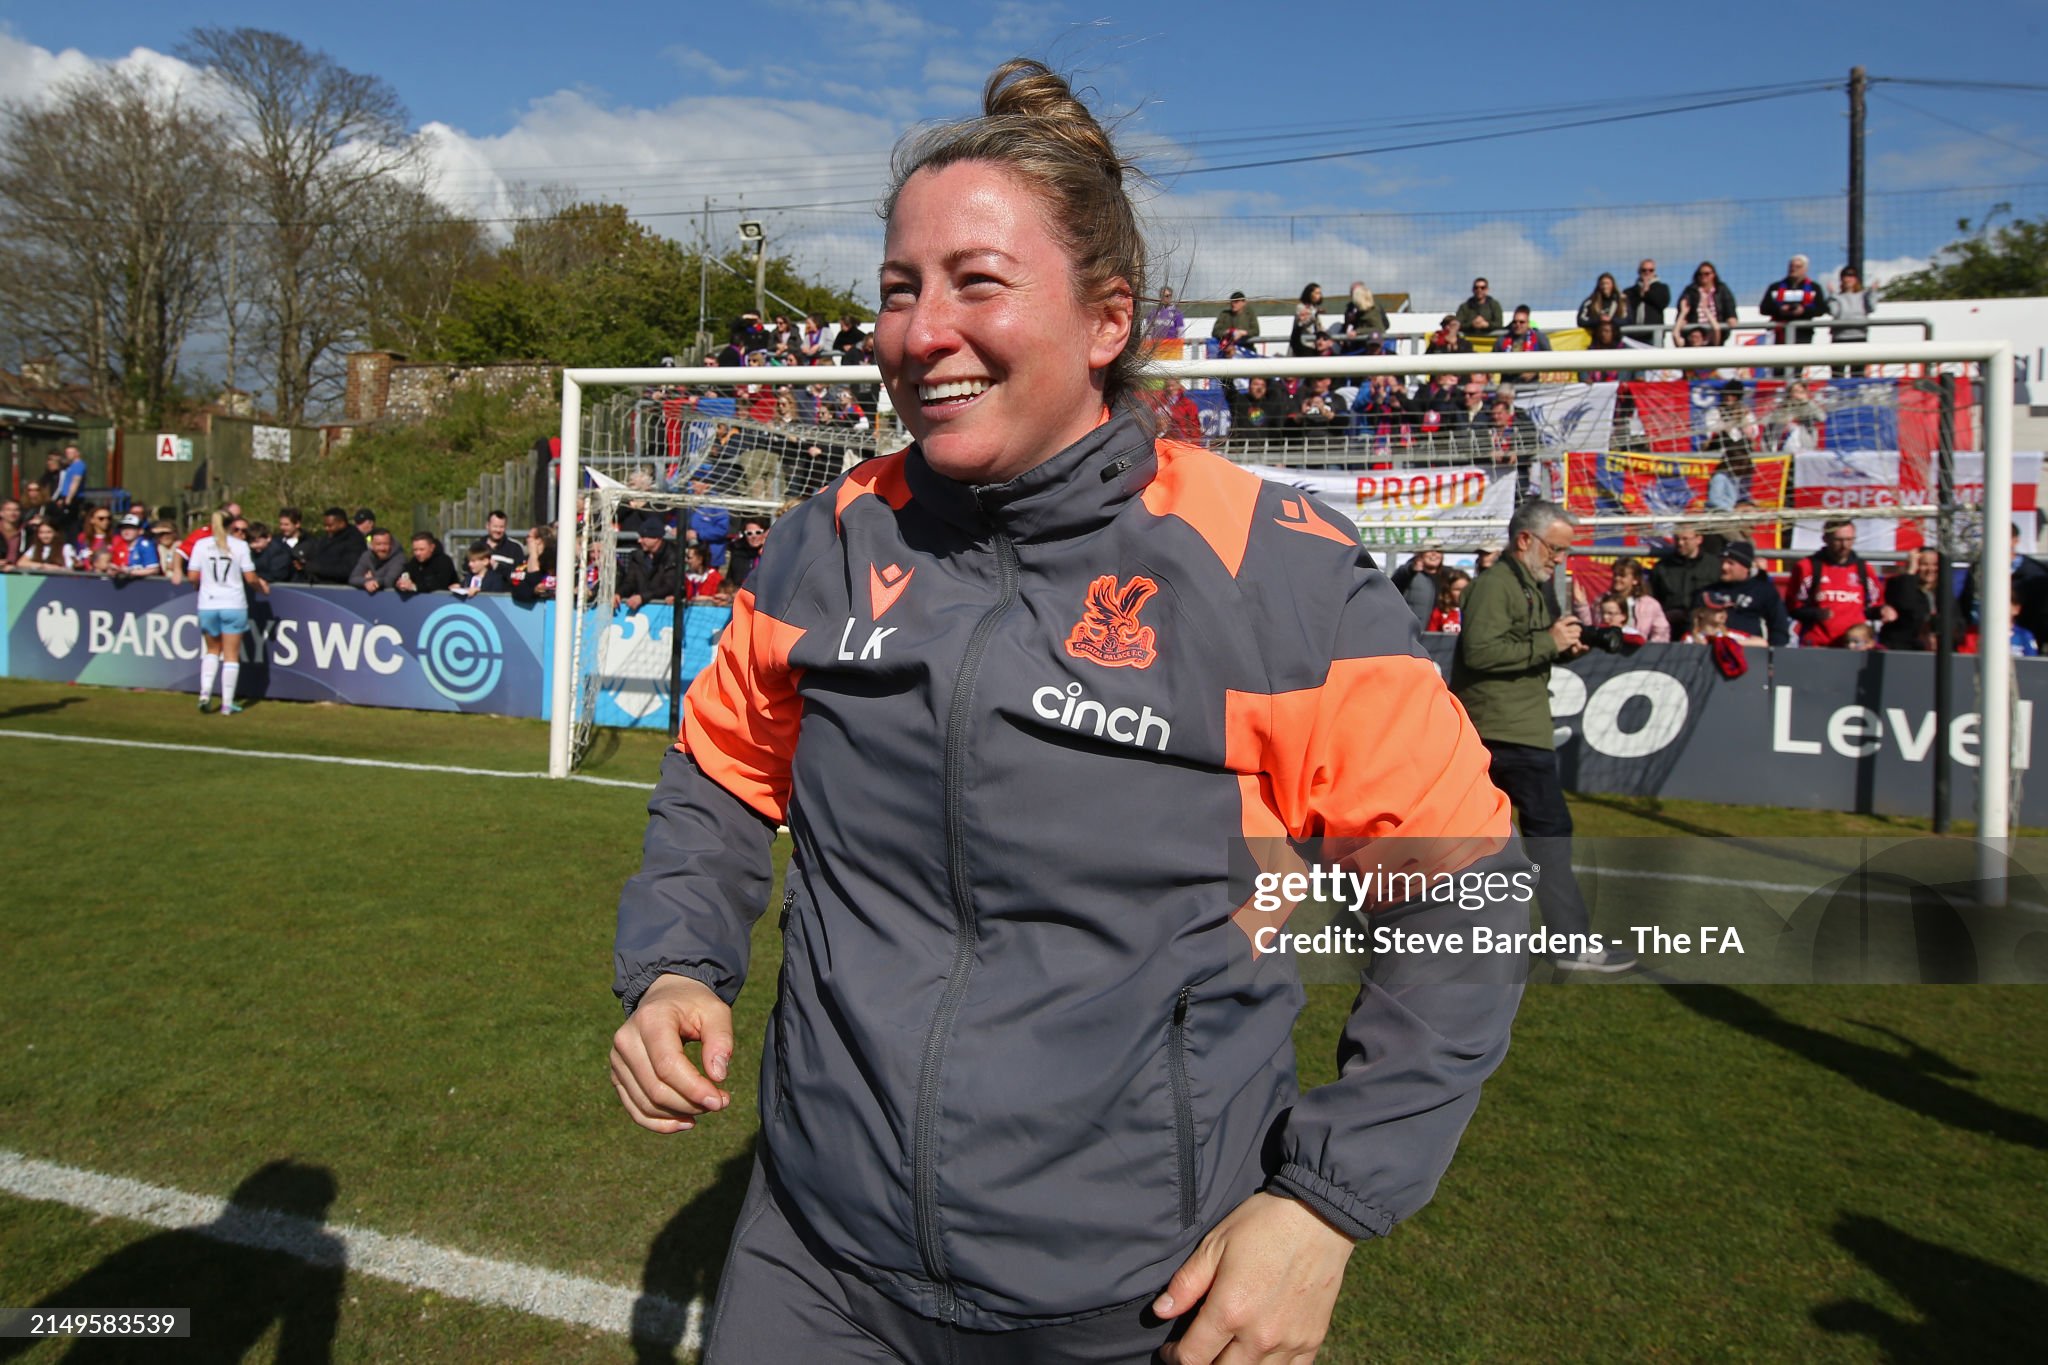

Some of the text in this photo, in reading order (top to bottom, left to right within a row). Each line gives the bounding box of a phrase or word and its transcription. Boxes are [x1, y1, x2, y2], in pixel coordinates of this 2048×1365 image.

[160, 437, 174, 457] A
[1356, 472, 1486, 510] PROUD
[1822, 489, 1894, 509] CPFC
[208, 556, 233, 583] 17
[1825, 590, 1863, 604] TDK
[88, 609, 405, 675] BARCYS WC
[1076, 643, 1103, 658] CRYSTAL
[1104, 651, 1131, 661] PALACE
[1032, 681, 1172, 751] cinch
[1773, 685, 2033, 771] Level
